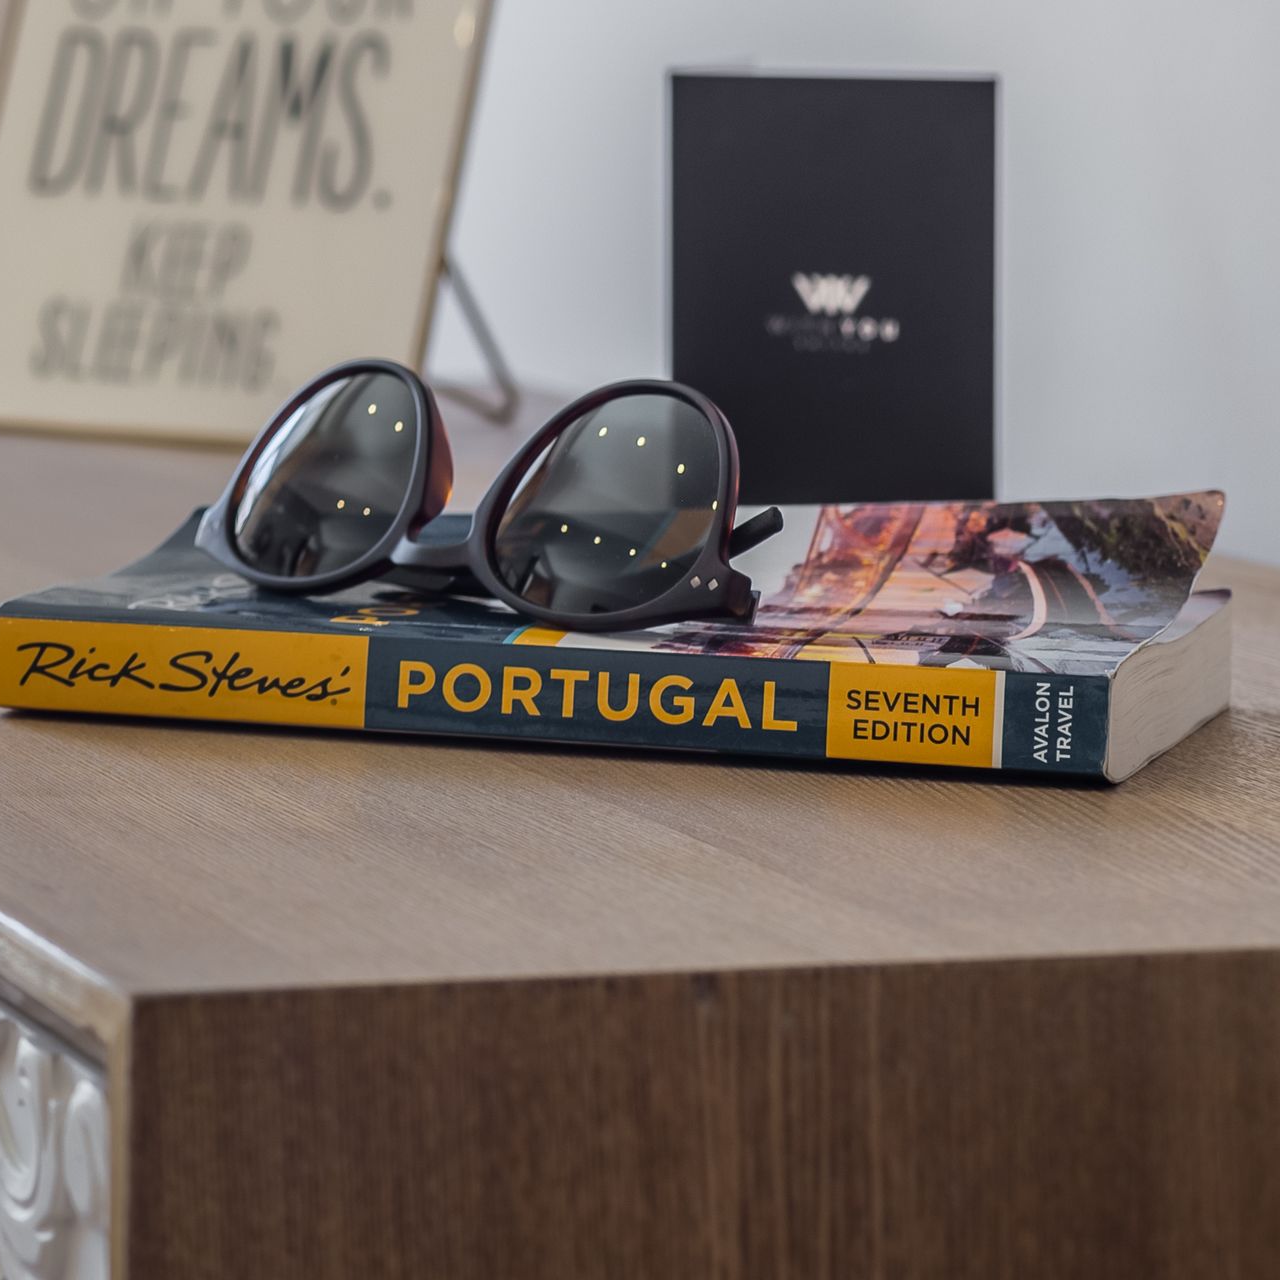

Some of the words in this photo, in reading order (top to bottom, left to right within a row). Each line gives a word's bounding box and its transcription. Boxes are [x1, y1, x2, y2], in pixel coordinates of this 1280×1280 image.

[26, 25, 393, 215] DREAMS.
[16, 641, 156, 687] Rick
[396, 659, 799, 733] PORTUGAL
[845, 688, 981, 718] SEVENTH
[852, 718, 972, 747] EDITION
[1032, 681, 1052, 764] AVALON
[1055, 685, 1075, 763] TRAVEL
